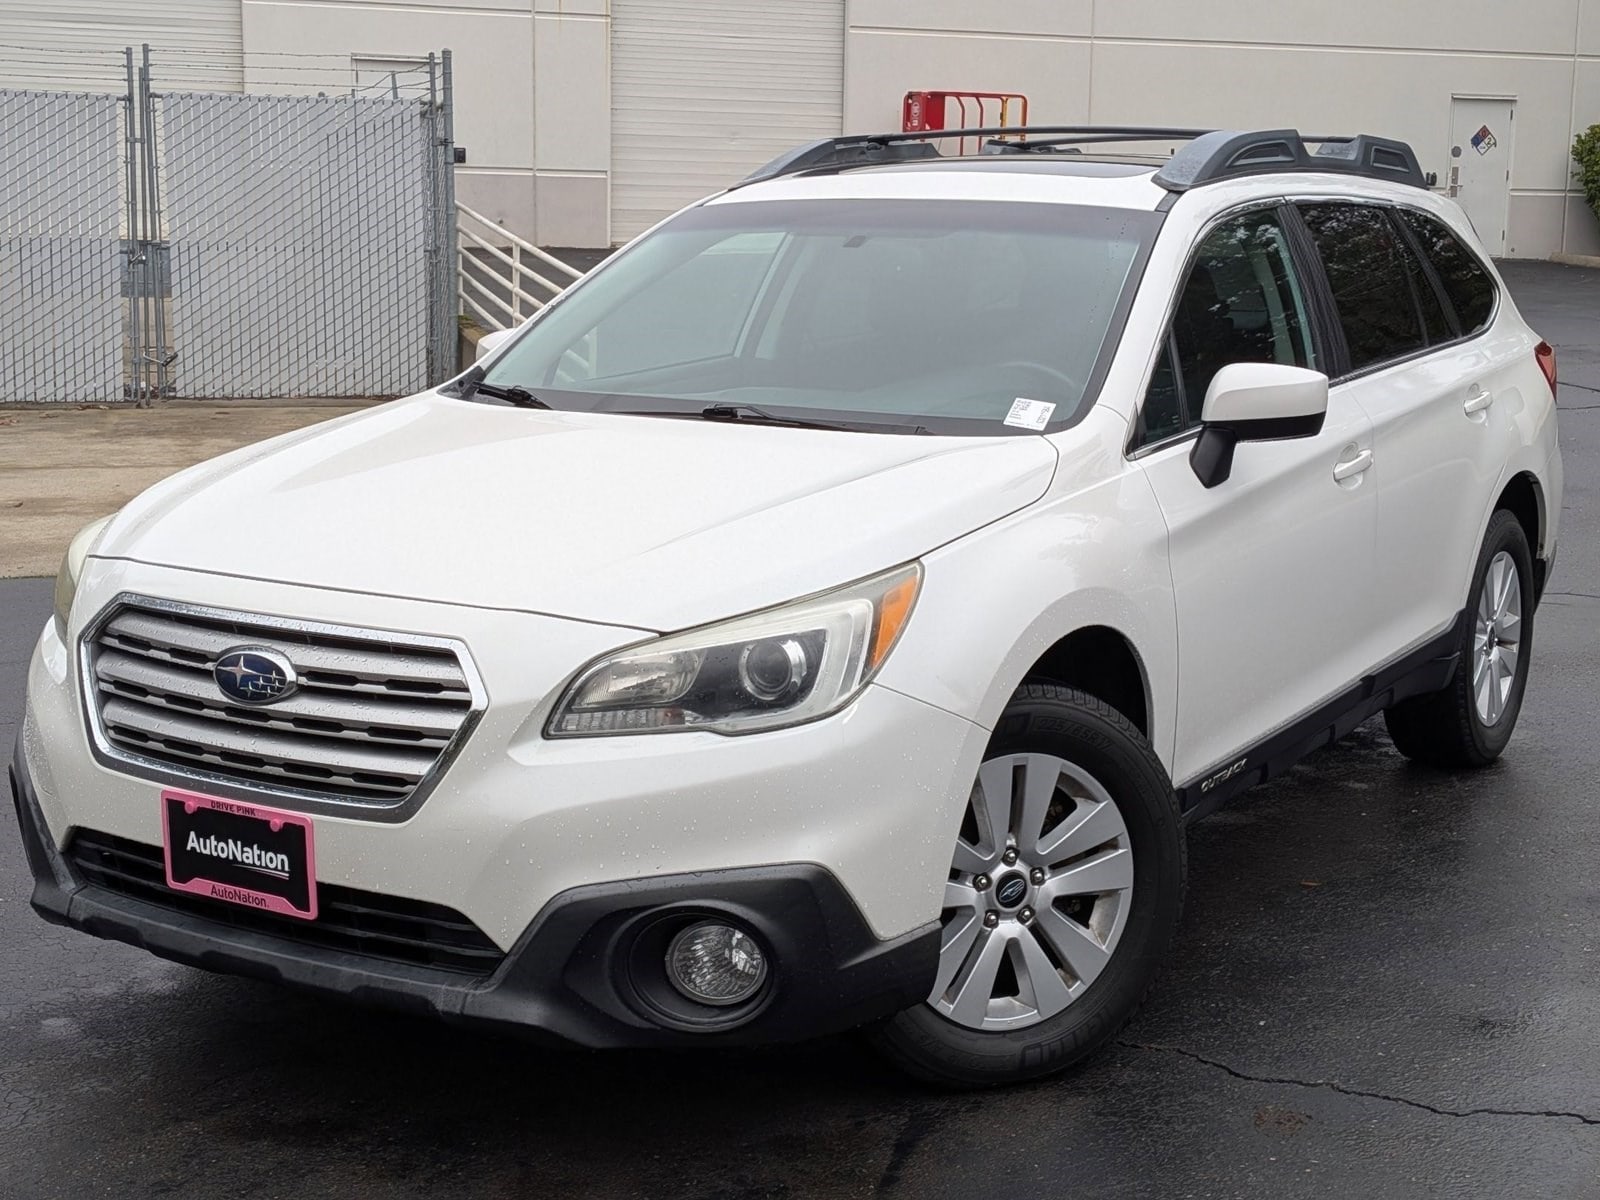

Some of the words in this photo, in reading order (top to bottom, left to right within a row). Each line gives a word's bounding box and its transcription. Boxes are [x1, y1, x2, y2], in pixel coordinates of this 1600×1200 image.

[210, 801, 235, 812] DRIVE
[236, 804, 256, 816] PINK
[186, 831, 290, 872] AutoNation
[210, 885, 267, 907] AutoNation
